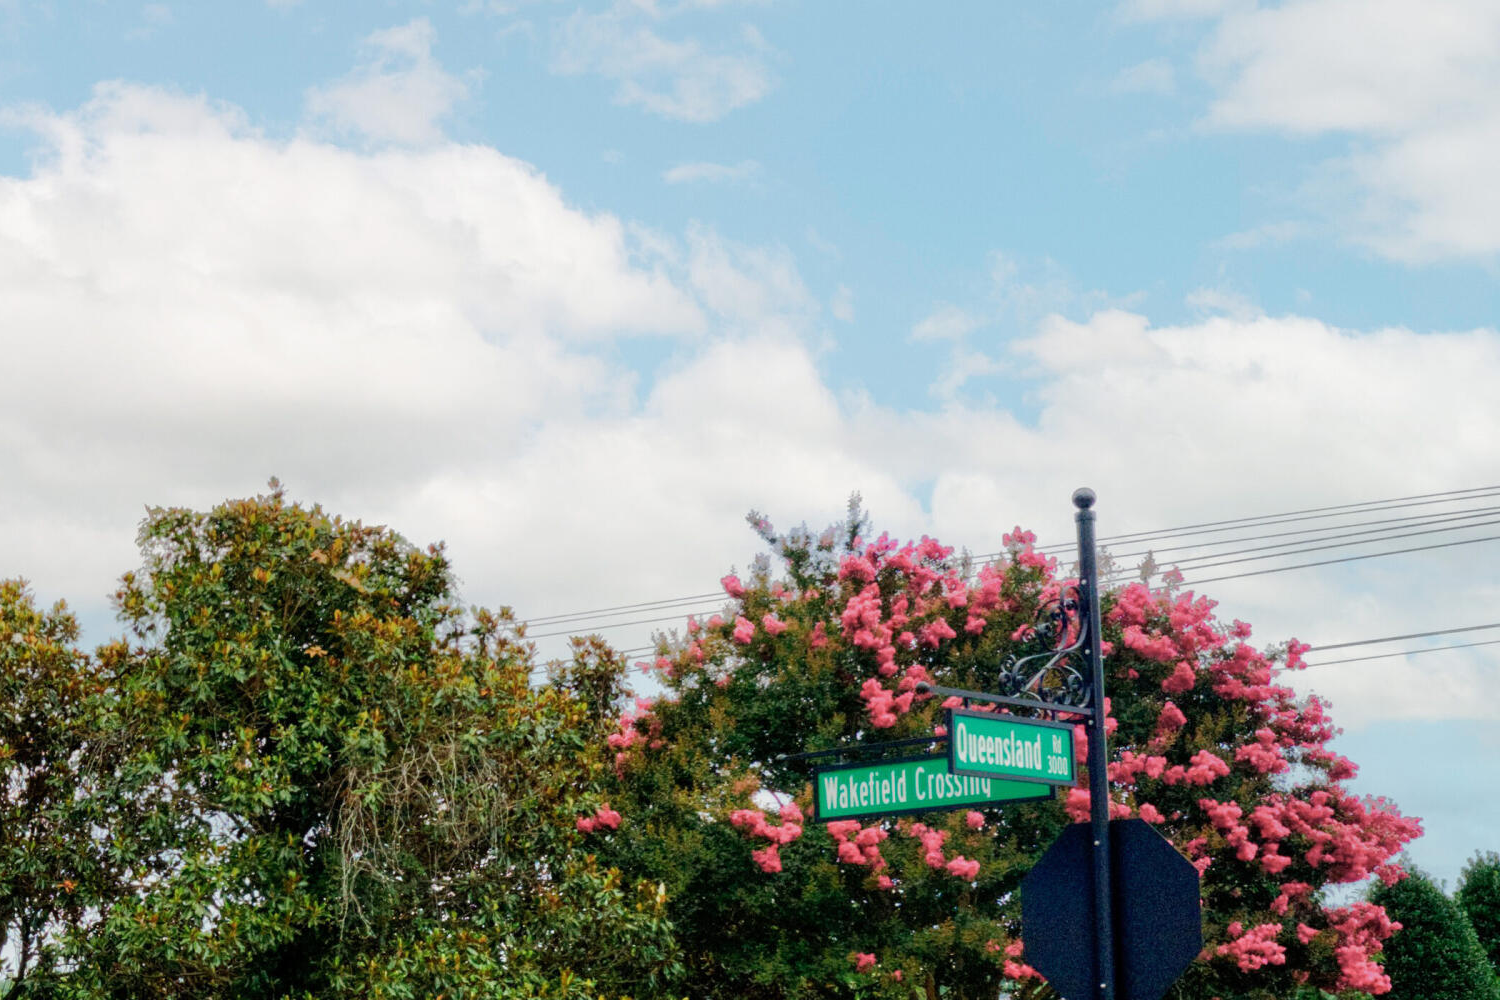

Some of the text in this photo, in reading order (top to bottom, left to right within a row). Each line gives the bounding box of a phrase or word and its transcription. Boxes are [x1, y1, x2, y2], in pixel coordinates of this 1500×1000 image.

[956, 722, 1042, 771] Queensland
[1052, 734, 1062, 754] Rd
[1047, 754, 1068, 776] 3000
[824, 769, 907, 810] Wakefield
